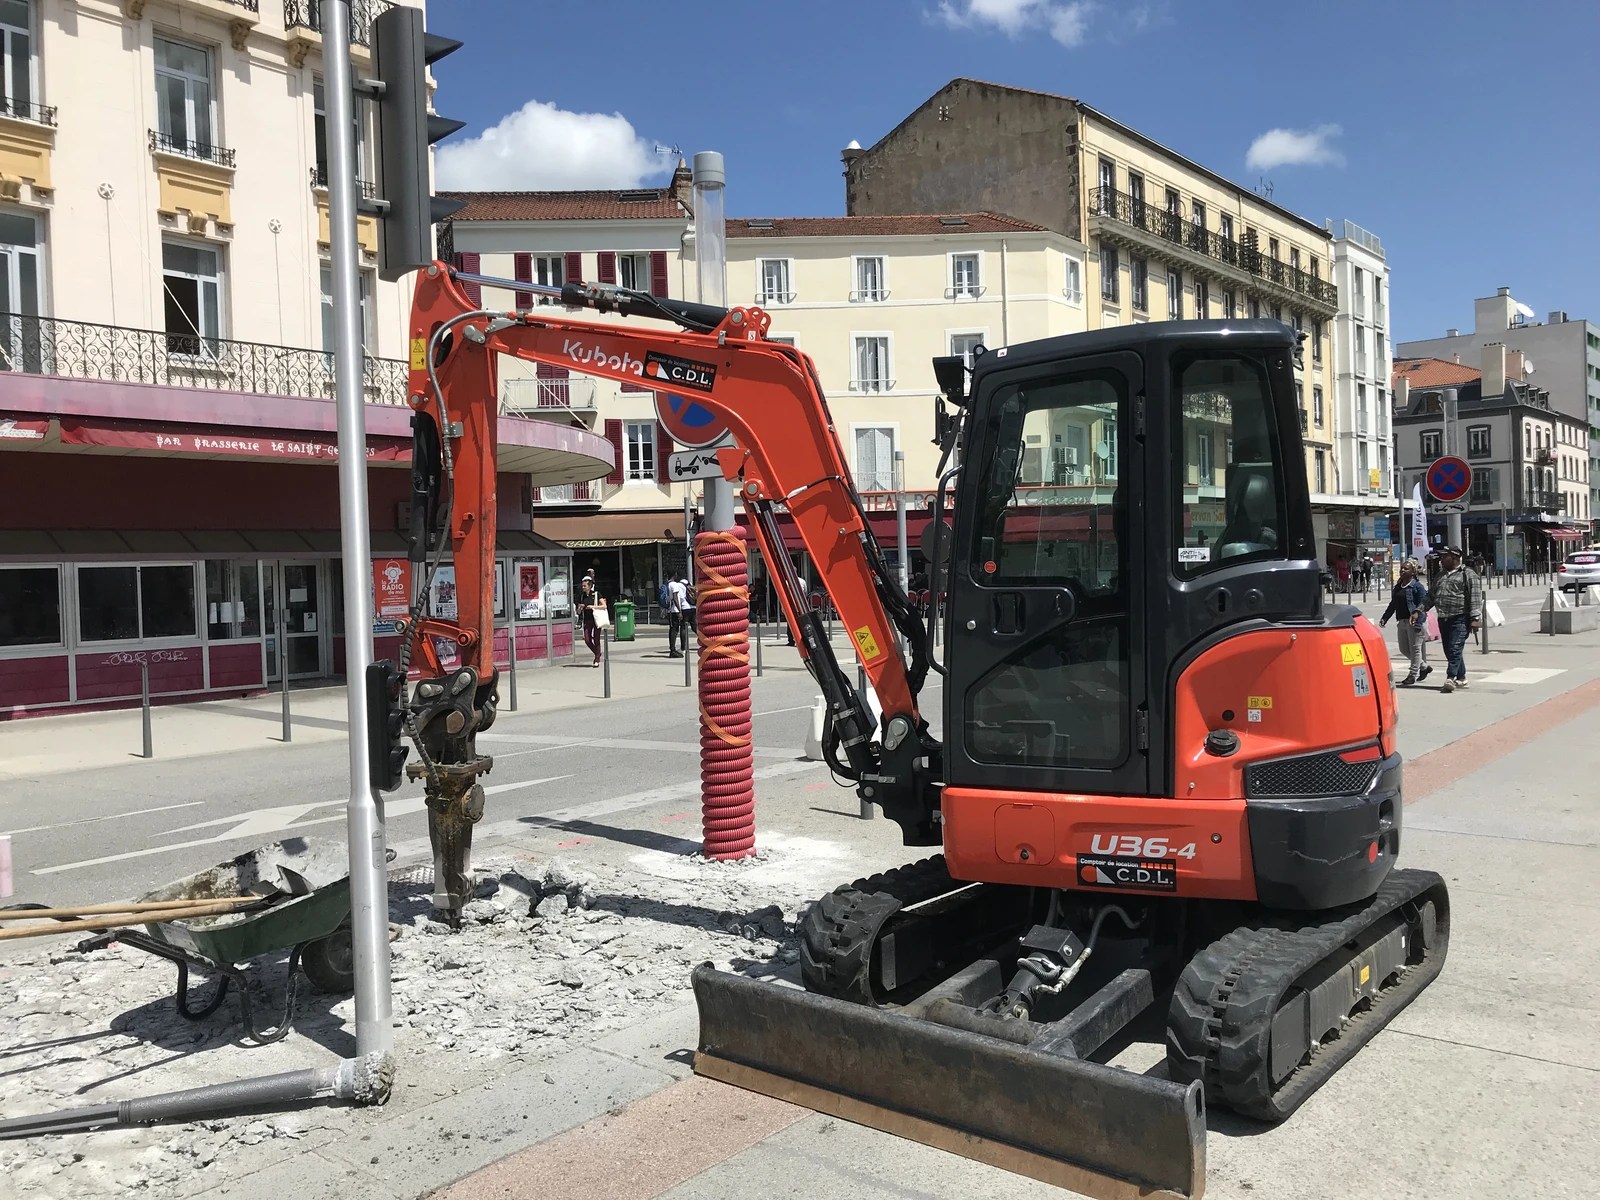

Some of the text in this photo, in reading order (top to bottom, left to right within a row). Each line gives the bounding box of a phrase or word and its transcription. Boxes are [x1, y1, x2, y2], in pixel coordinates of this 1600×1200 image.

[562, 338, 644, 377] Kubota
[648, 354, 668, 364] Comptoir
[671, 366, 712, 385] C.D.L.
[156, 434, 182, 448] BAR
[194, 436, 260, 452] BRASSERIE
[1415, 503, 1423, 536] EIFFAG
[381, 583, 404, 591] RADIO
[1355, 679, 1365, 694] 94
[1090, 834, 1196, 860] U36-4
[1080, 858, 1106, 867] Comptoir
[1116, 860, 1139, 868] location
[1116, 868, 1174, 885] C.D.L.
